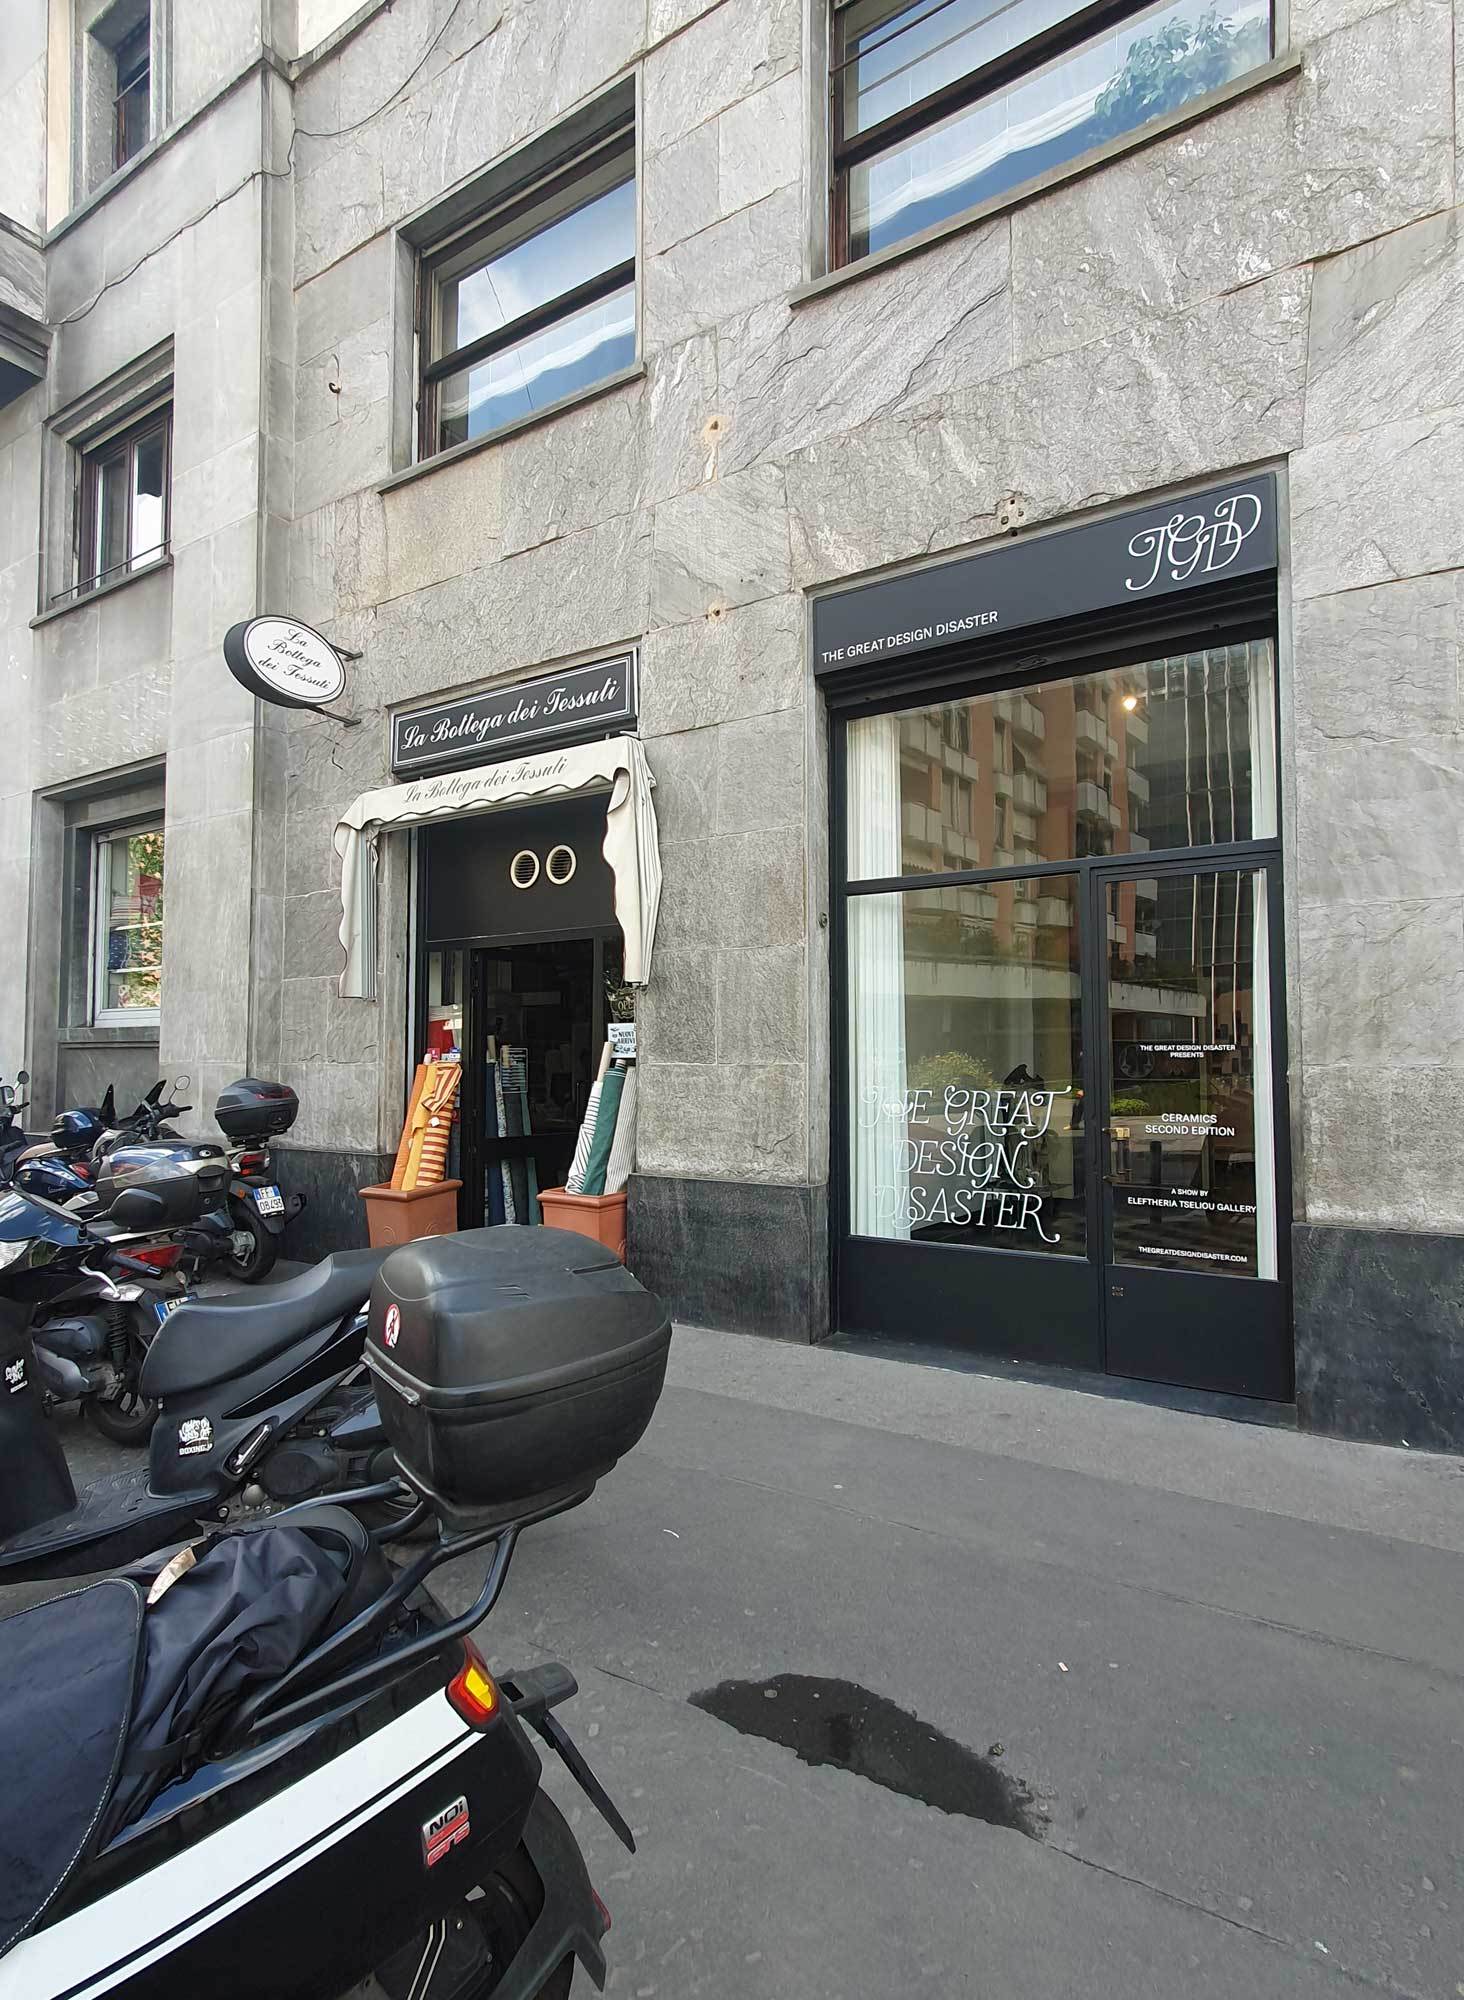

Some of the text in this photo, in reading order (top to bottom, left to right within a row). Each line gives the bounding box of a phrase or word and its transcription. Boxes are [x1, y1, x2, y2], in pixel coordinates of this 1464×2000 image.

[284, 628, 308, 647] La
[822, 611, 998, 664] THE GREAT DESIGN DISASTER
[267, 639, 321, 668] Bottega
[258, 657, 331, 689] dei Tessuti
[400, 677, 621, 750] La Bottega dei Tessuti
[404, 756, 568, 803] La Bottega dei Tessuti
[618, 1000, 634, 1010] OPE
[1140, 1044, 1153, 1052] THE
[1154, 1044, 1175, 1052] GREAT
[1176, 1044, 1201, 1052] DESIGN
[858, 1085, 1072, 1139] THE GREAT
[1161, 1113, 1217, 1124] CERAMICS
[1145, 1125, 1235, 1137] SECOND EDITION
[895, 1133, 1035, 1189] DESIGN
[1177, 1188, 1198, 1196] SHOW
[1200, 1189, 1208, 1197] BY
[873, 1186, 1061, 1243] DISASTER
[1127, 1197, 1257, 1213] ELEFTHERIA TSELIOU GALLERY
[1138, 1246, 1248, 1263] THEGREATDESIGNDISASTER.COM
